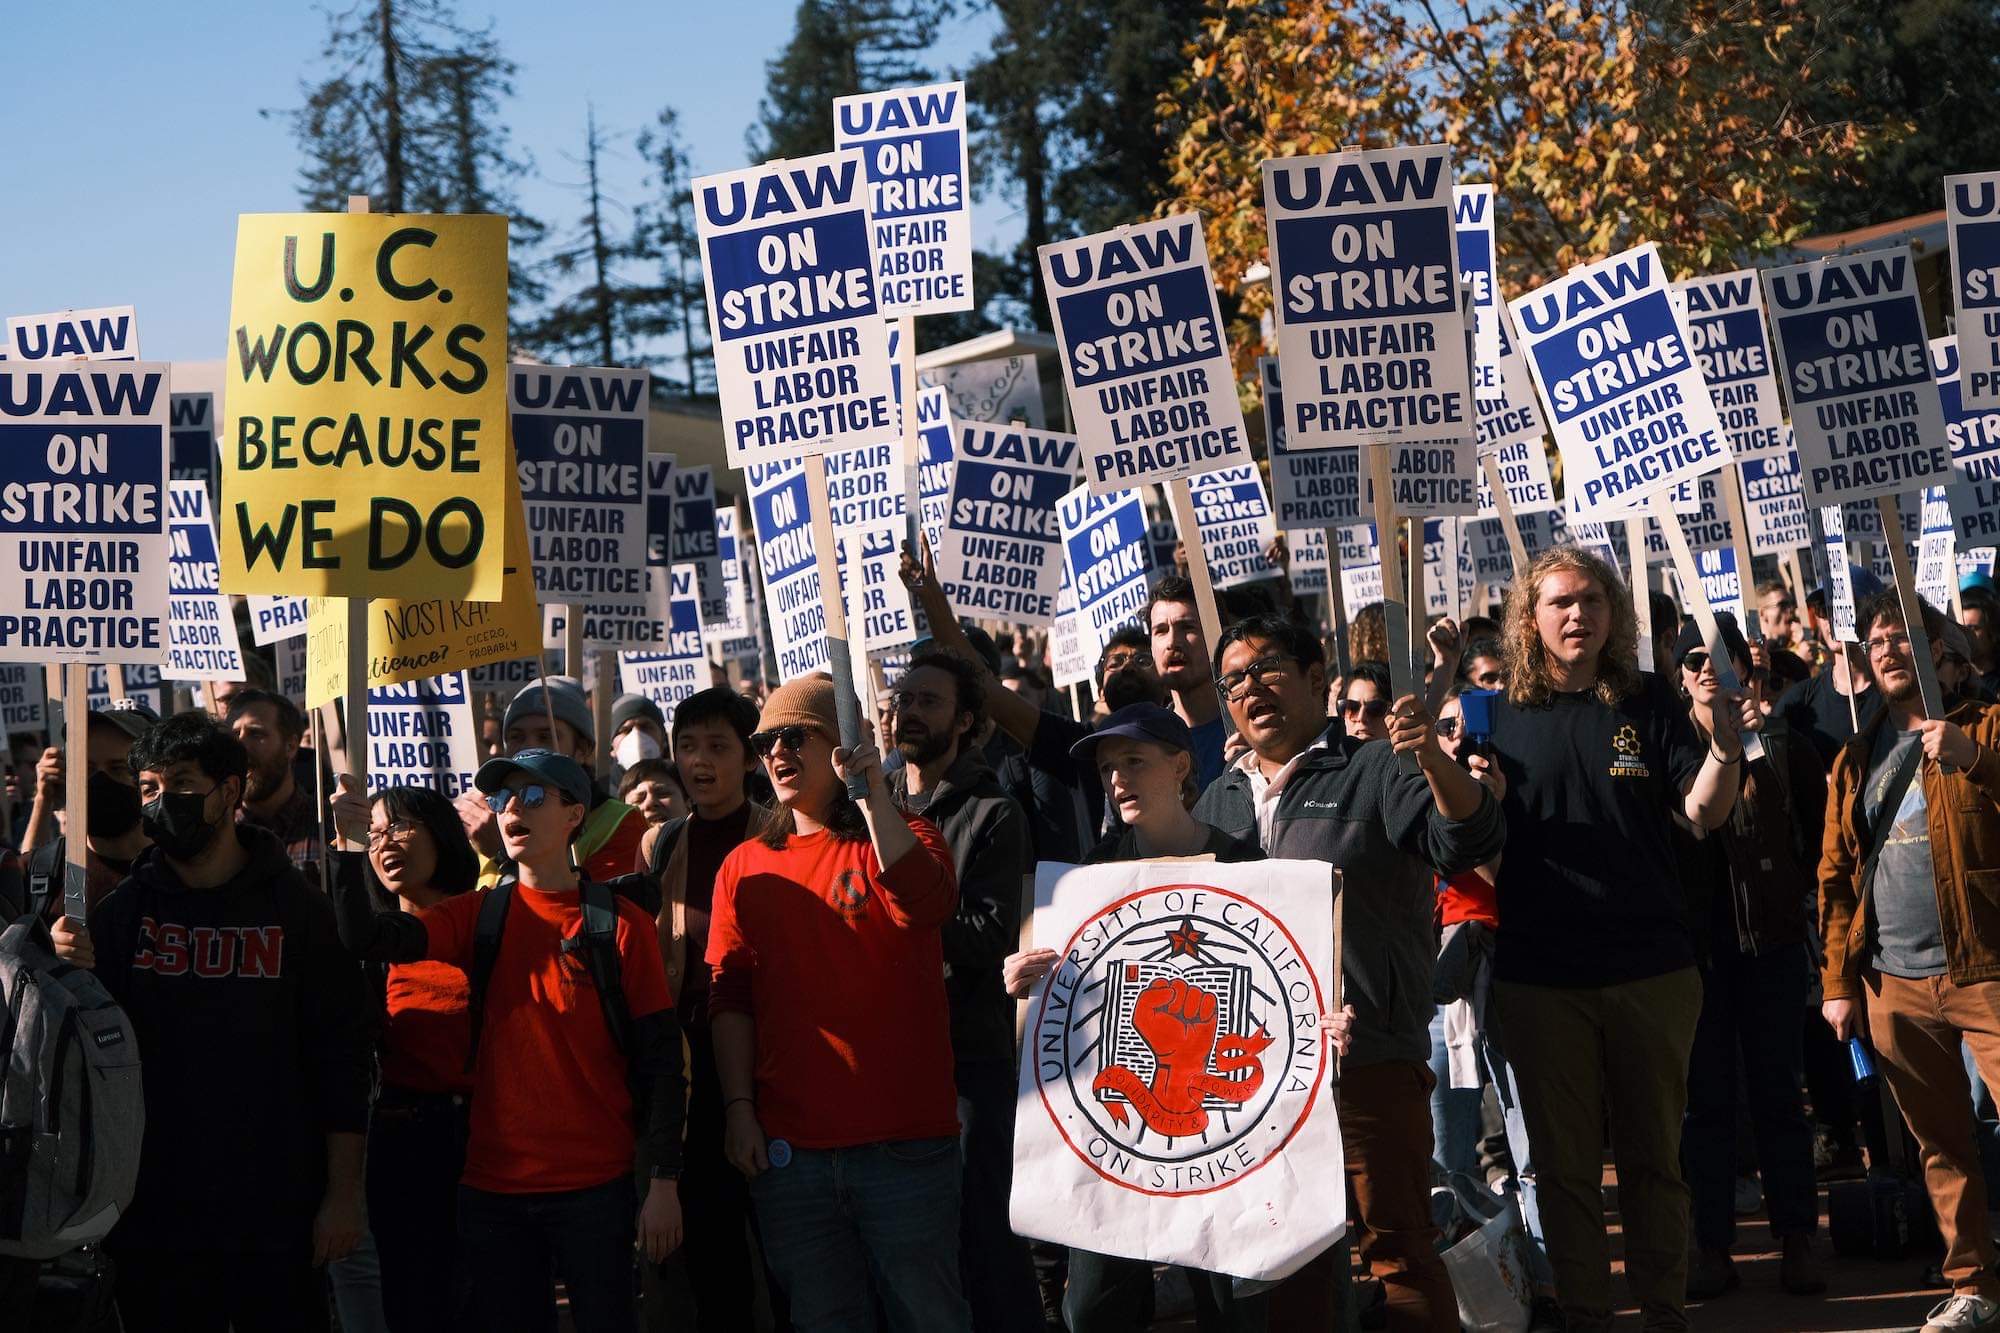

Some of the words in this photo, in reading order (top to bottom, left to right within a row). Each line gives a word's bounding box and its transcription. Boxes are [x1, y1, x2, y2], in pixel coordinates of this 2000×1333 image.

[840, 90, 957, 136] UAW
[876, 140, 923, 175] ON
[702, 159, 858, 227] UAW
[868, 173, 959, 213] TRIKE
[1273, 156, 1443, 211] UAW
[757, 227, 818, 275] ON
[877, 219, 948, 249] NFAIR
[1331, 220, 1395, 264] ON
[879, 248, 944, 278] ABOR
[1049, 223, 1194, 288] UAW
[722, 267, 871, 330] STRIKE
[882, 273, 965, 305] ACTICE
[1288, 264, 1449, 314] STRIKE
[1519, 252, 1651, 335] UAW
[1686, 277, 1753, 315] AW
[1771, 255, 1906, 310] UAW
[1106, 284, 1163, 327] ON
[16, 316, 130, 360] UAW
[1074, 316, 1216, 377] STRIKE
[1310, 321, 1436, 360] UNFAIR
[1576, 313, 1632, 361] ON
[1825, 310, 1879, 350] ON
[236, 319, 489, 394] WORKS
[744, 326, 861, 374] UNFAIR
[1701, 345, 1765, 380] RIKE
[1794, 343, 1925, 394] STRIKE
[514, 373, 644, 412] UAW
[754, 364, 860, 410] LABOR
[1098, 368, 1210, 415] UNFAIR
[1319, 358, 1433, 396] LABOR
[1553, 334, 1685, 413] STRIKE
[0, 373, 162, 416] UAW
[1296, 392, 1463, 434] PRACTICE
[1580, 382, 1684, 442] UNFAIR
[1710, 382, 1759, 410] FAIR
[1816, 391, 1920, 431] UNFAIR
[238, 412, 482, 473] BECAUSE
[553, 423, 602, 457] ON
[735, 395, 890, 451] PRACTICE
[1110, 400, 1211, 446] LABOR
[1594, 412, 1689, 470] LABOR
[1828, 422, 1921, 460] LABOR
[1946, 413, 2000, 453] STR
[47, 433, 108, 475] ON
[825, 444, 891, 477] NFAIR
[963, 428, 1076, 468] UAW
[1094, 426, 1242, 482] PRACTICE
[1288, 454, 1359, 477] UNFAIR
[1392, 448, 1456, 475] ABOR
[1763, 456, 1793, 476] ON
[517, 460, 639, 496] STRIKE
[828, 471, 888, 501] ABOR
[990, 470, 1034, 501] ON
[1188, 466, 1252, 488] AW
[1295, 476, 1359, 499] LABOR
[1584, 429, 1722, 507] PRACTICE
[1747, 472, 1802, 500] STRIK
[1812, 447, 1948, 494] PRACTICE
[1, 482, 156, 524] STRIKE
[771, 486, 798, 529] ON
[830, 493, 906, 527] ACTICE
[1200, 487, 1235, 506] ON
[1394, 478, 1473, 505] ACTICE
[1759, 498, 1801, 516] UNFAI
[529, 506, 625, 534] UNFAIR
[954, 498, 1059, 537] STRIKE
[1195, 499, 1267, 524] TRIKE
[235, 499, 341, 574] WE
[367, 496, 485, 571] DO
[533, 536, 619, 563] LABOR
[961, 536, 1045, 567] UNFAIR
[1090, 517, 1121, 558] ON
[1756, 528, 1807, 548] PRACTI
[19, 540, 139, 573] UNFAIR
[169, 561, 220, 590] RIKE
[962, 560, 1038, 590] LABOR
[1701, 549, 1722, 574] ON
[25, 578, 133, 611] LABOR
[533, 566, 639, 593] RACTICE
[776, 571, 820, 614] UNFAIR
[1350, 570, 1381, 585] UNFAI
[1700, 571, 1738, 601] TRIKE
[169, 600, 220, 621] NFAIR
[943, 582, 1052, 617] PRACTICE
[1092, 582, 1148, 629] UNFAIR
[0, 615, 160, 649] PRACTICE
[367, 645, 450, 680] tience?
[637, 663, 697, 685] UNFAIR
[368, 710, 453, 738] UNFAIR
[373, 742, 452, 769] LABOR
[1608, 767, 1650, 777] UNITED
[132, 916, 285, 979] CSUN
[1041, 897, 1145, 1083] UNIVERSITY
[1164, 890, 1208, 915] OF
[1222, 901, 1316, 1094] CALIFORNIA
[1104, 1071, 1183, 1128] SOLIDARITY
[1200, 1076, 1255, 1098] POWER
[1088, 1138, 1130, 1174] ON
[1151, 1142, 1256, 1189] STRIKE
